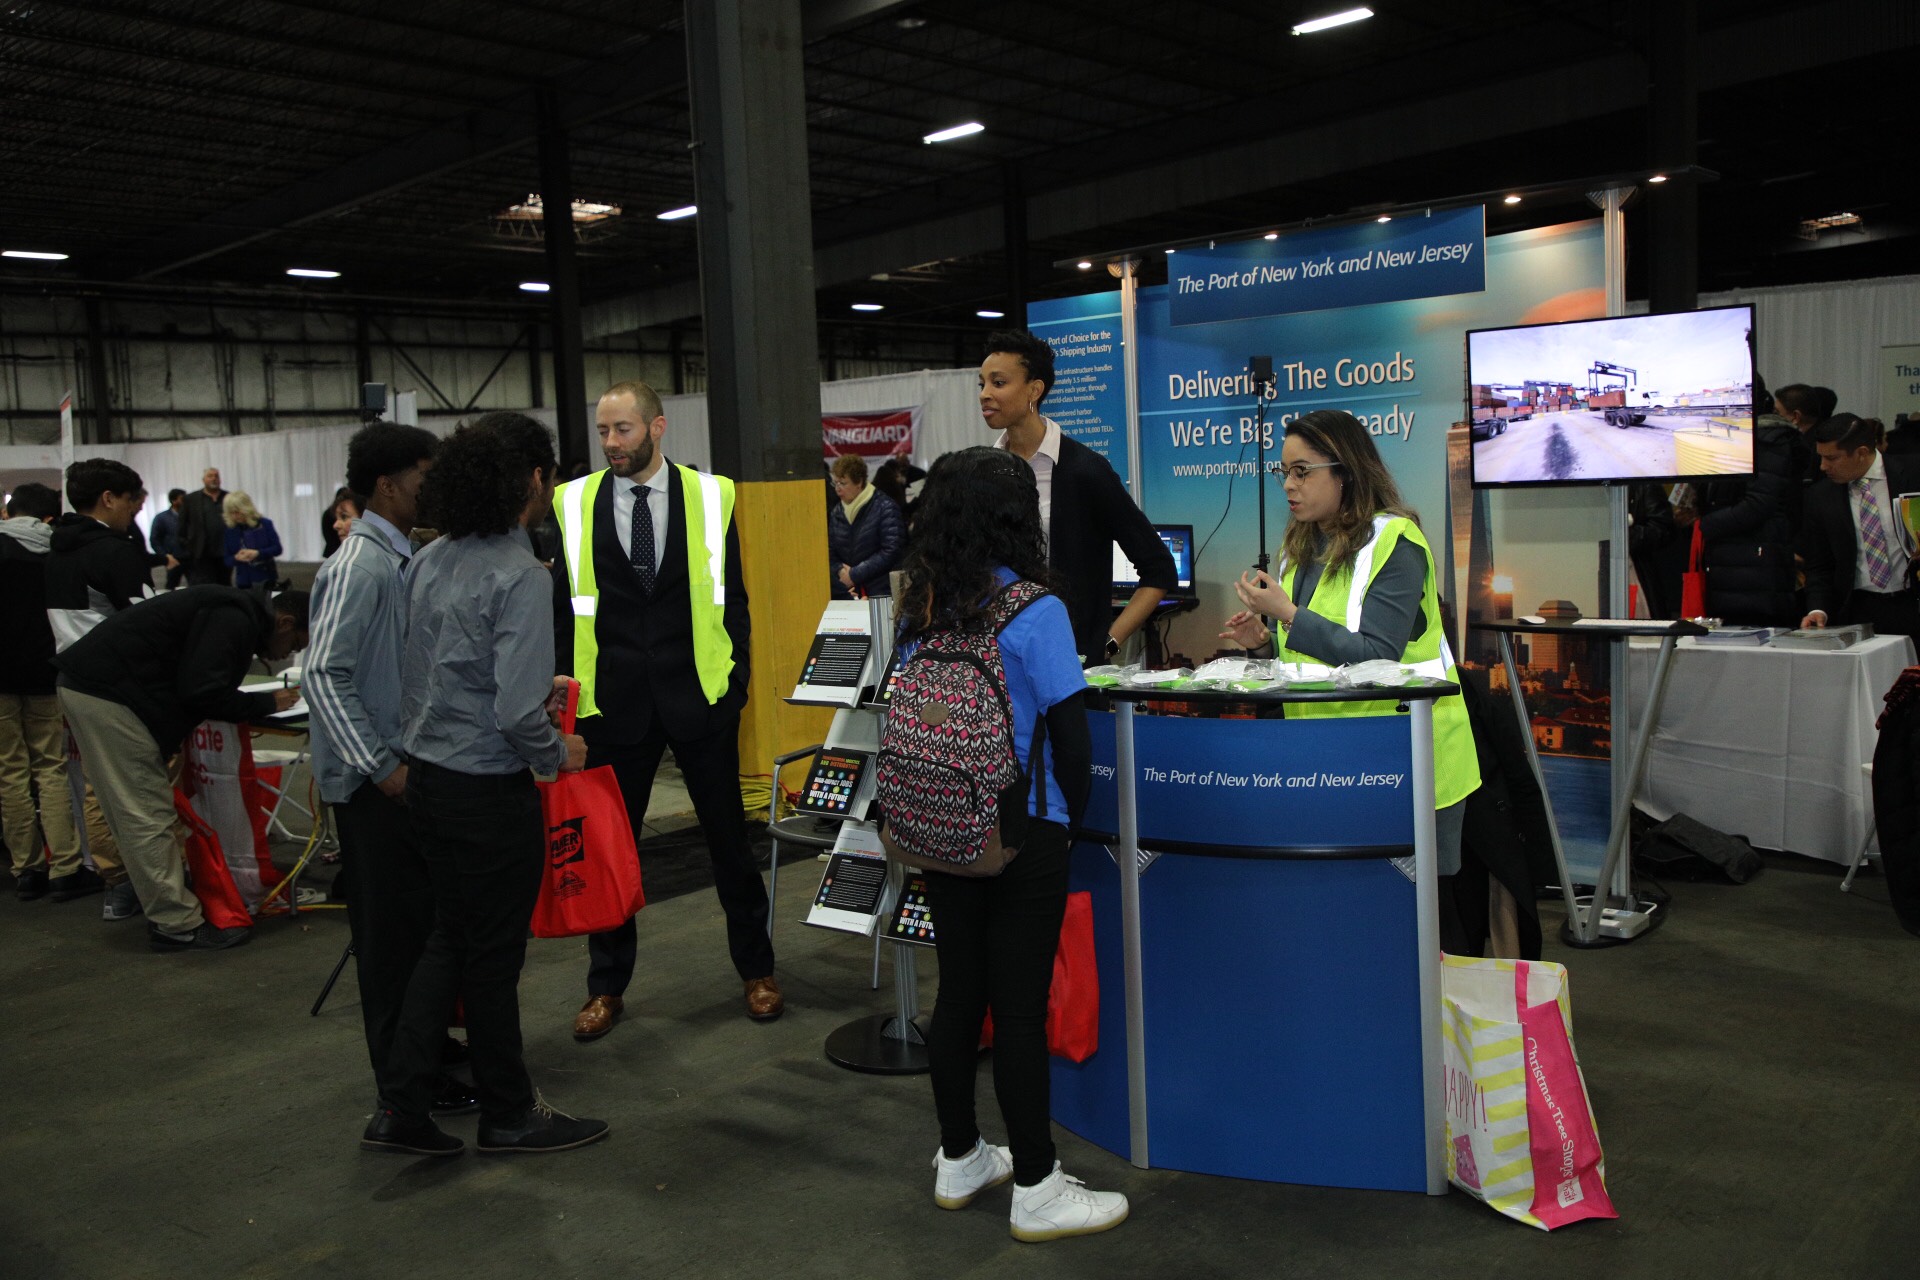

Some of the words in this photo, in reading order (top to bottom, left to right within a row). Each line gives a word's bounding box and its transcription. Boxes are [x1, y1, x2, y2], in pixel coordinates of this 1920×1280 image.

[1178, 275, 1204, 294] The
[1208, 272, 1239, 290] Port
[1241, 267, 1259, 286] of
[1260, 266, 1297, 284] New
[1301, 256, 1335, 278] York
[1338, 251, 1372, 273] and
[1375, 250, 1416, 269] New
[1418, 243, 1473, 263] Jersey
[1048, 337, 1060, 345] Port
[1061, 335, 1068, 344] of
[1068, 333, 1089, 342] Choice
[1090, 332, 1099, 340] for
[1100, 330, 1111, 339] the
[1060, 347, 1086, 357] Shipping
[1086, 344, 1112, 353] Industry
[1283, 361, 1327, 391] The
[1335, 351, 1415, 387] Goods
[1169, 418, 1232, 447] We're
[1240, 415, 1274, 449] Big
[1343, 404, 1415, 441] eady
[1090, 764, 1115, 780] ersey
[1144, 767, 1167, 782] The
[1170, 769, 1196, 785] Port
[1198, 771, 1214, 785] of
[1215, 772, 1249, 787] New
[1252, 773, 1282, 788] York
[1286, 772, 1317, 788] and
[1320, 773, 1355, 787] New
[1357, 772, 1404, 788] Jersey
[1527, 1037, 1555, 1110] Christmas
[1553, 1106, 1567, 1141] Tree
